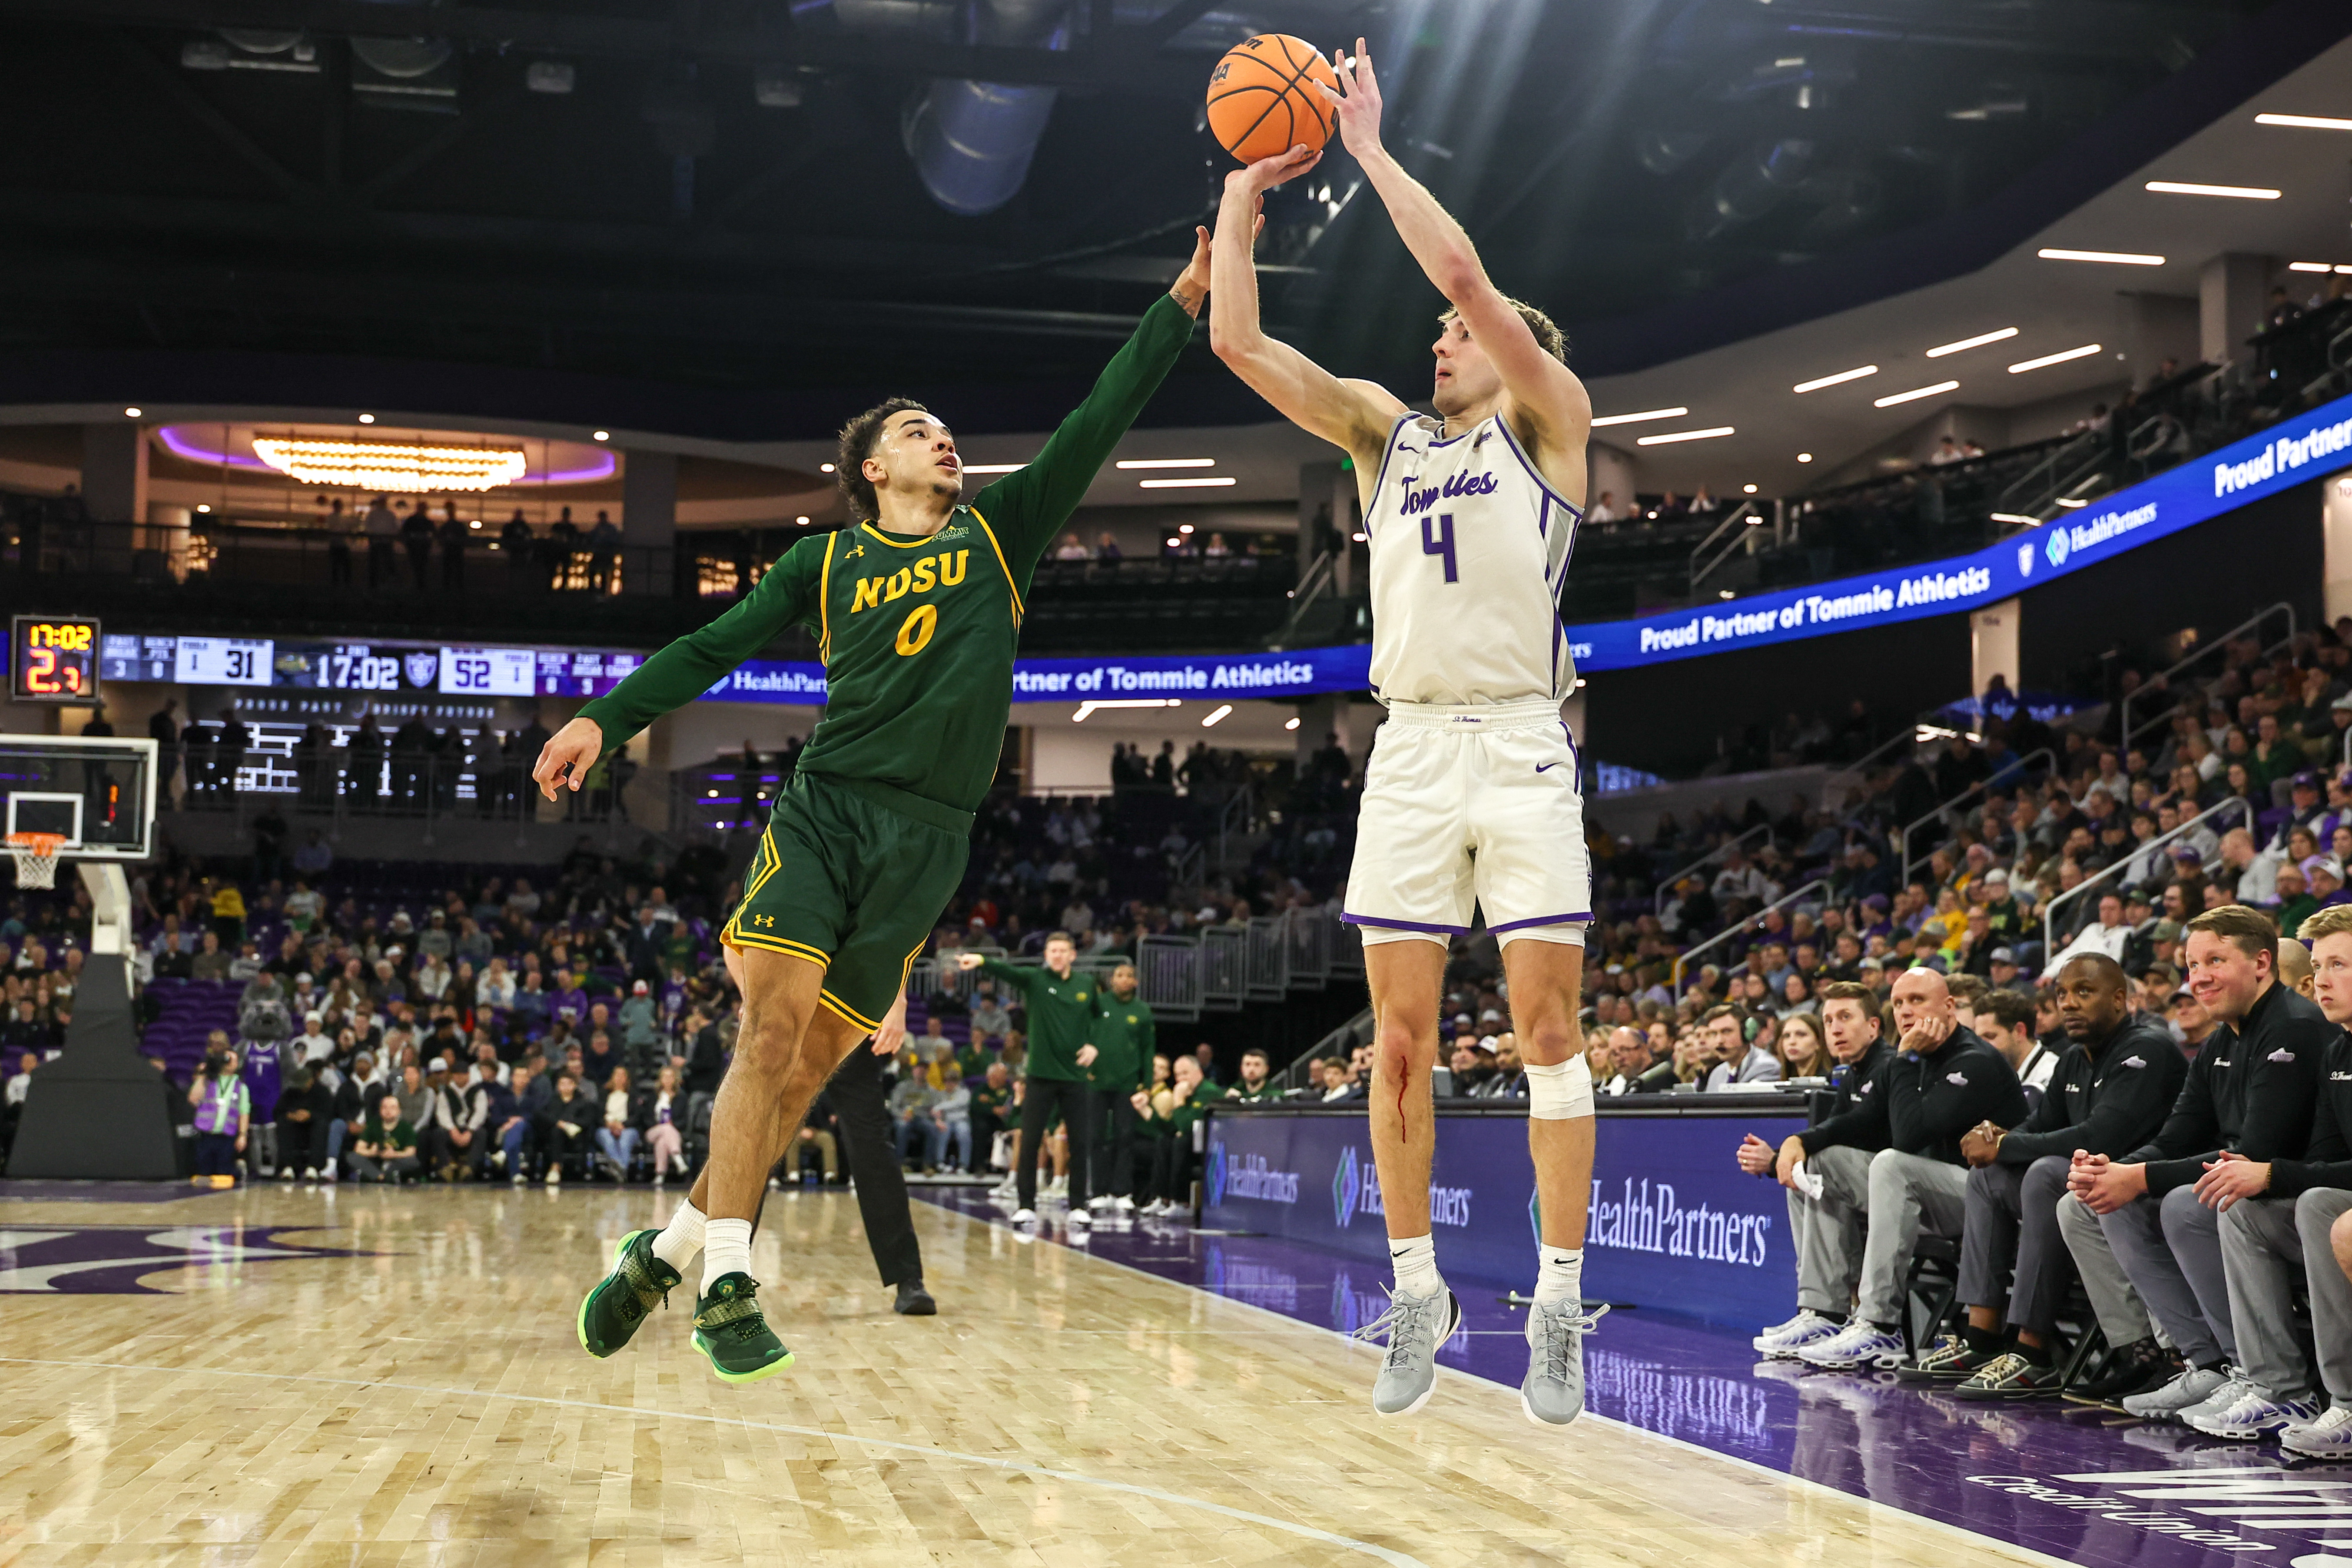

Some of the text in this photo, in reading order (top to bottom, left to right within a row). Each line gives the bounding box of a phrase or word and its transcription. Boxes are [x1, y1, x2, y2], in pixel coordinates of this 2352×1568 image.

[2215, 418, 2352, 497] Proud Partner
[931, 527, 969, 542] SUMMIT
[1421, 512, 1459, 584] 4
[2071, 502, 2157, 553] HealthPartners
[851, 549, 969, 613] NDSU
[895, 603, 937, 656] 0
[1640, 566, 1990, 653] Proud Partner of Tommie Athletics
[30, 624, 92, 650] 17:02
[27, 648, 80, 693] 2.7
[226, 650, 254, 679] 31
[316, 654, 399, 690] 17:02
[455, 659, 491, 688] 52
[733, 671, 827, 695] HealthPart
[1013, 660, 1314, 692] rtner of Tommie Athletics
[1584, 1177, 1767, 1267] HealthPartners
[1964, 1474, 2277, 1551] Credit Union
